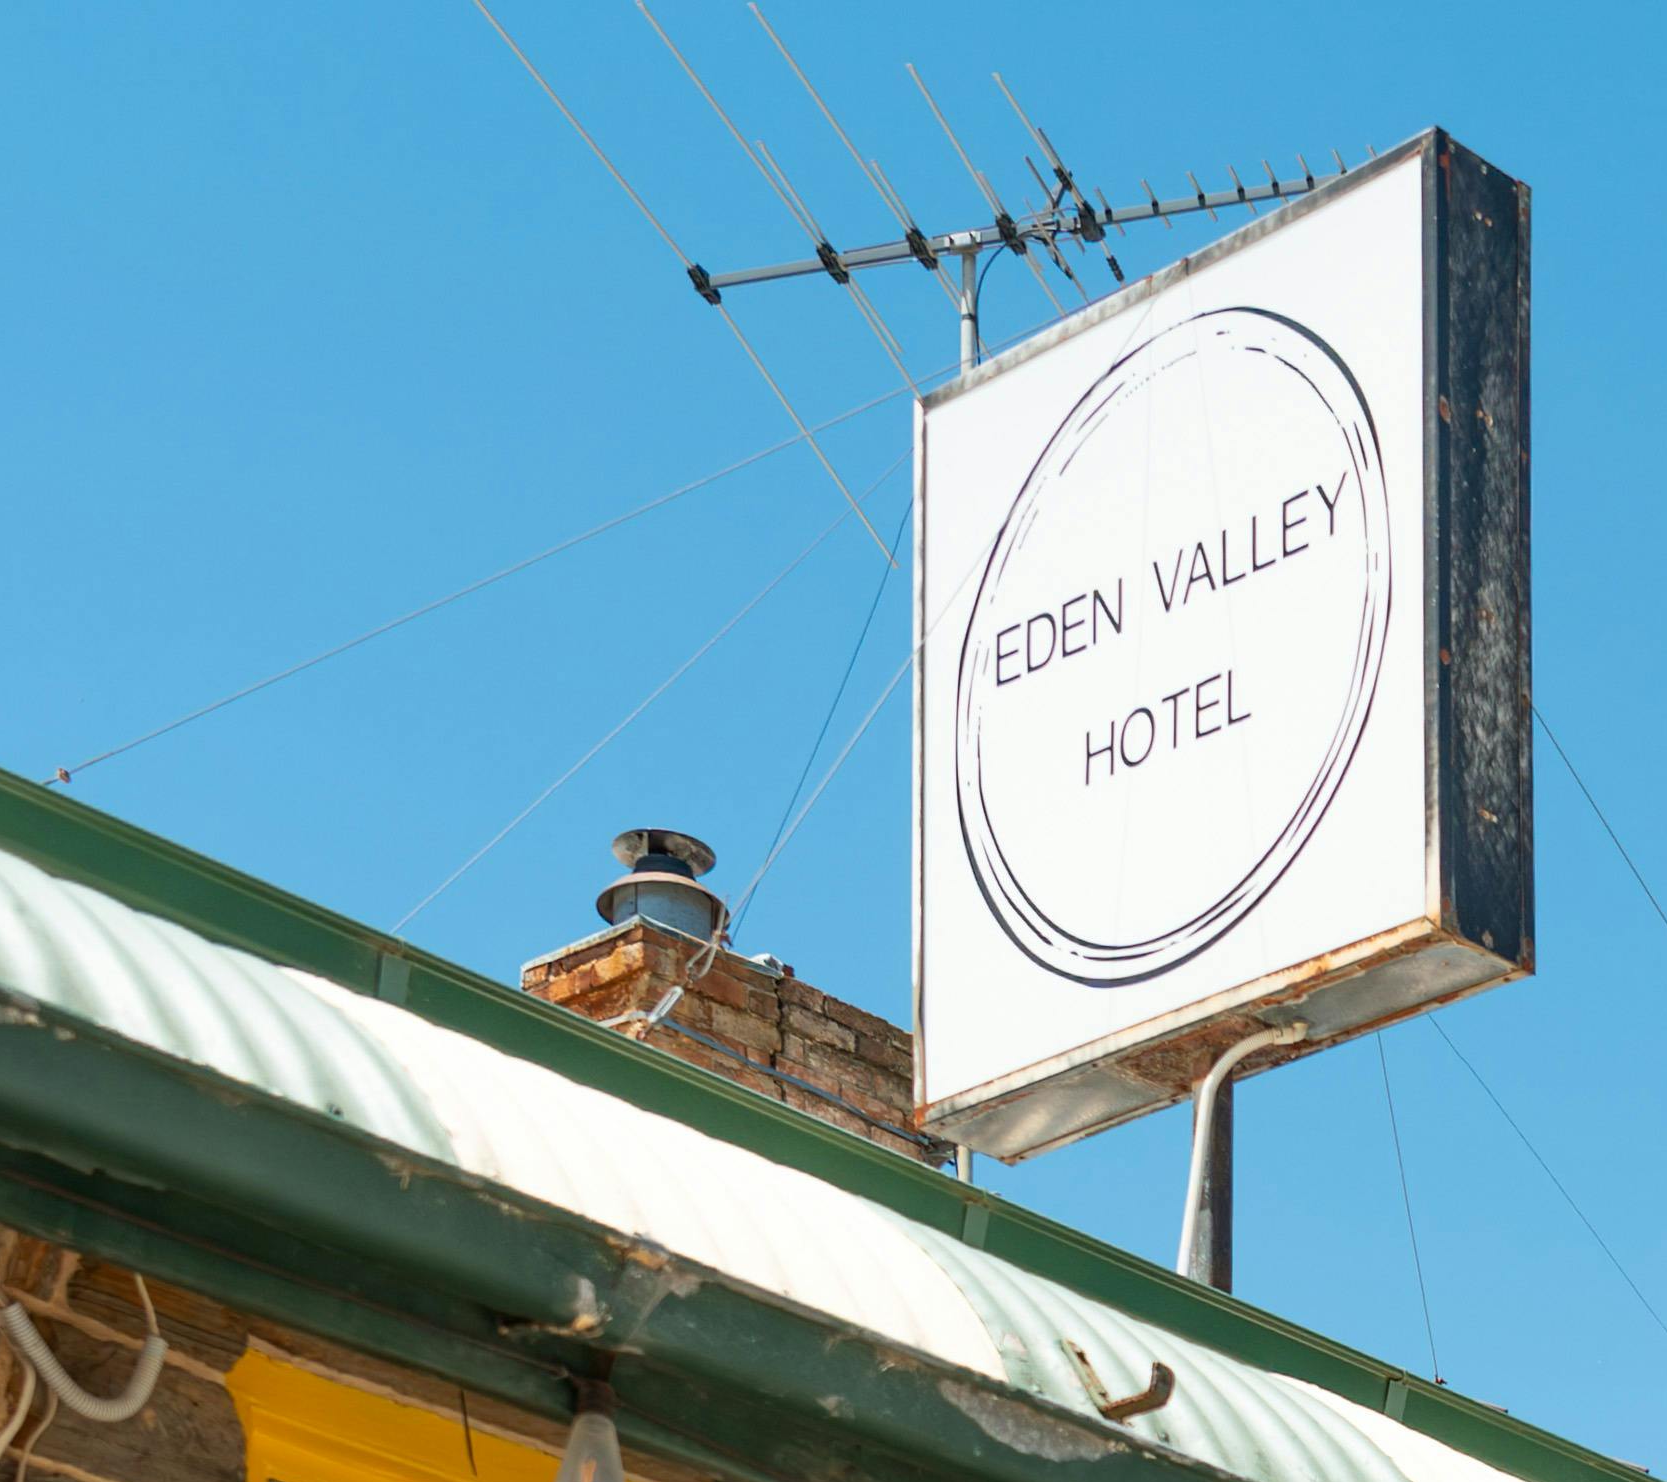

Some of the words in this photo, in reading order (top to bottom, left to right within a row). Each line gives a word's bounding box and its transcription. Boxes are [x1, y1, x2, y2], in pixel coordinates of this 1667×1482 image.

[995, 580, 1123, 688] EDEN
[1152, 471, 1347, 613] VALLEY
[1084, 669, 1252, 786] HOTEL
